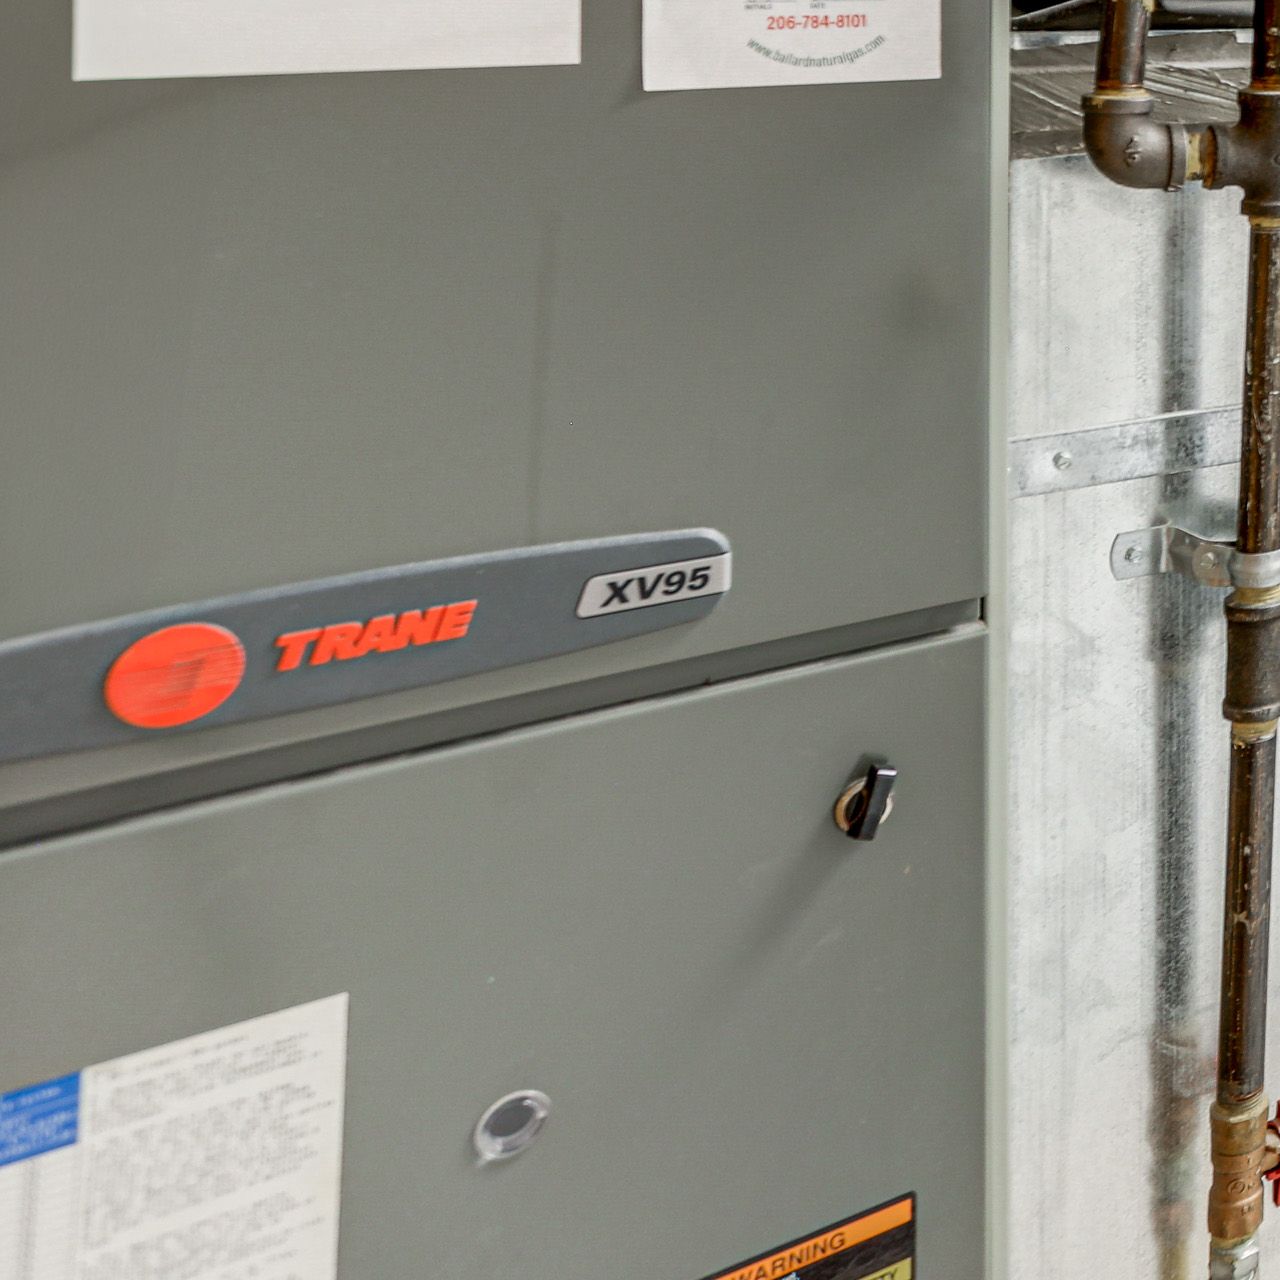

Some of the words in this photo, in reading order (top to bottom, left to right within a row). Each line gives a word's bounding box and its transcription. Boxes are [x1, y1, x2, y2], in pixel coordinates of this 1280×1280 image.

[766, 13, 868, 30] 206-784-8101
[746, 34, 886, 68] www.ballardnaturalgas.com
[600, 565, 712, 607] XV95
[275, 599, 478, 672] TRANE
